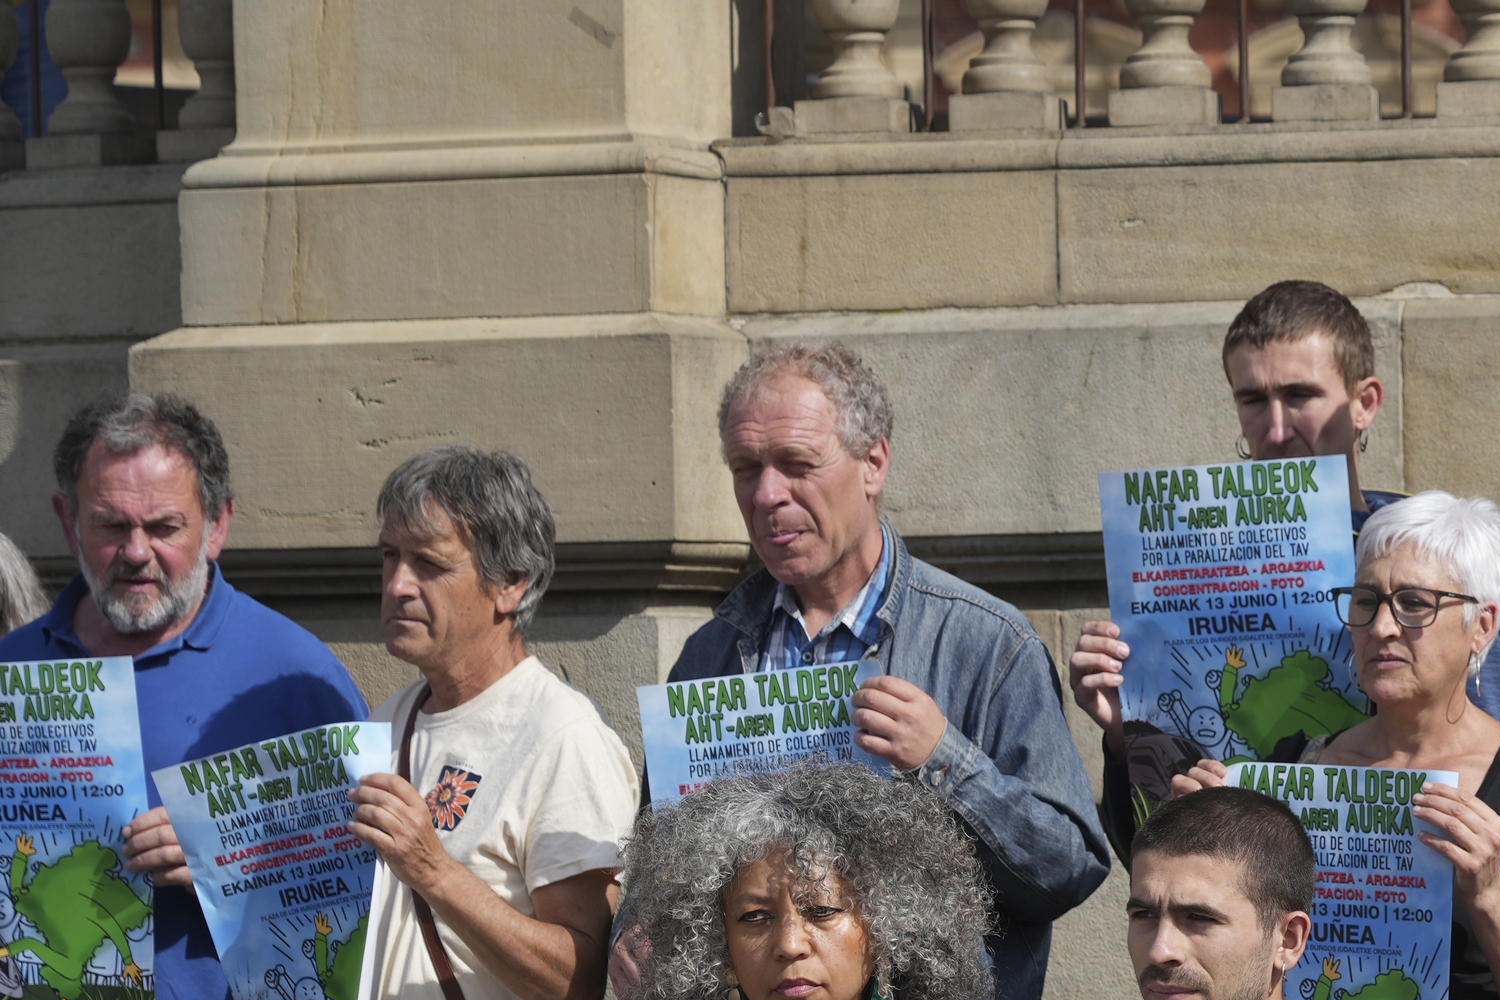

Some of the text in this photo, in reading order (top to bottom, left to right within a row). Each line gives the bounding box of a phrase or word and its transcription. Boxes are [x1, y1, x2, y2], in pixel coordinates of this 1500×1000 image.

[1125, 459, 1319, 505] NAFAR TALDEOK
[1233, 493, 1308, 527] AURKA
[1131, 593, 1278, 615] EKAINAK 13 JUNIO
[1187, 609, 1277, 636] IRUÑEA
[0, 659, 106, 696] TALDEOK
[666, 663, 861, 718] NAFAR TALDEOK
[21, 692, 95, 722] AURKA
[780, 698, 851, 734] AURKA
[26, 723, 95, 739] COLECTIVOS
[180, 724, 361, 796] NAFAR TALDEOK
[19, 784, 124, 799] JUNIO 12:00
[296, 758, 349, 796] AURKA
[1321, 767, 1425, 807] TALDEOK
[1345, 803, 1413, 836] AURKA
[1346, 837, 1412, 855] COLECTIVOS
[221, 856, 345, 898] EKAINAK 13 JUNIO
[277, 875, 350, 908] IRUÑEA
[1365, 873, 1426, 889] ARGAZKIA
[1332, 903, 1433, 923] JUNIO 12:00
[1374, 890, 1407, 903] FOTO
